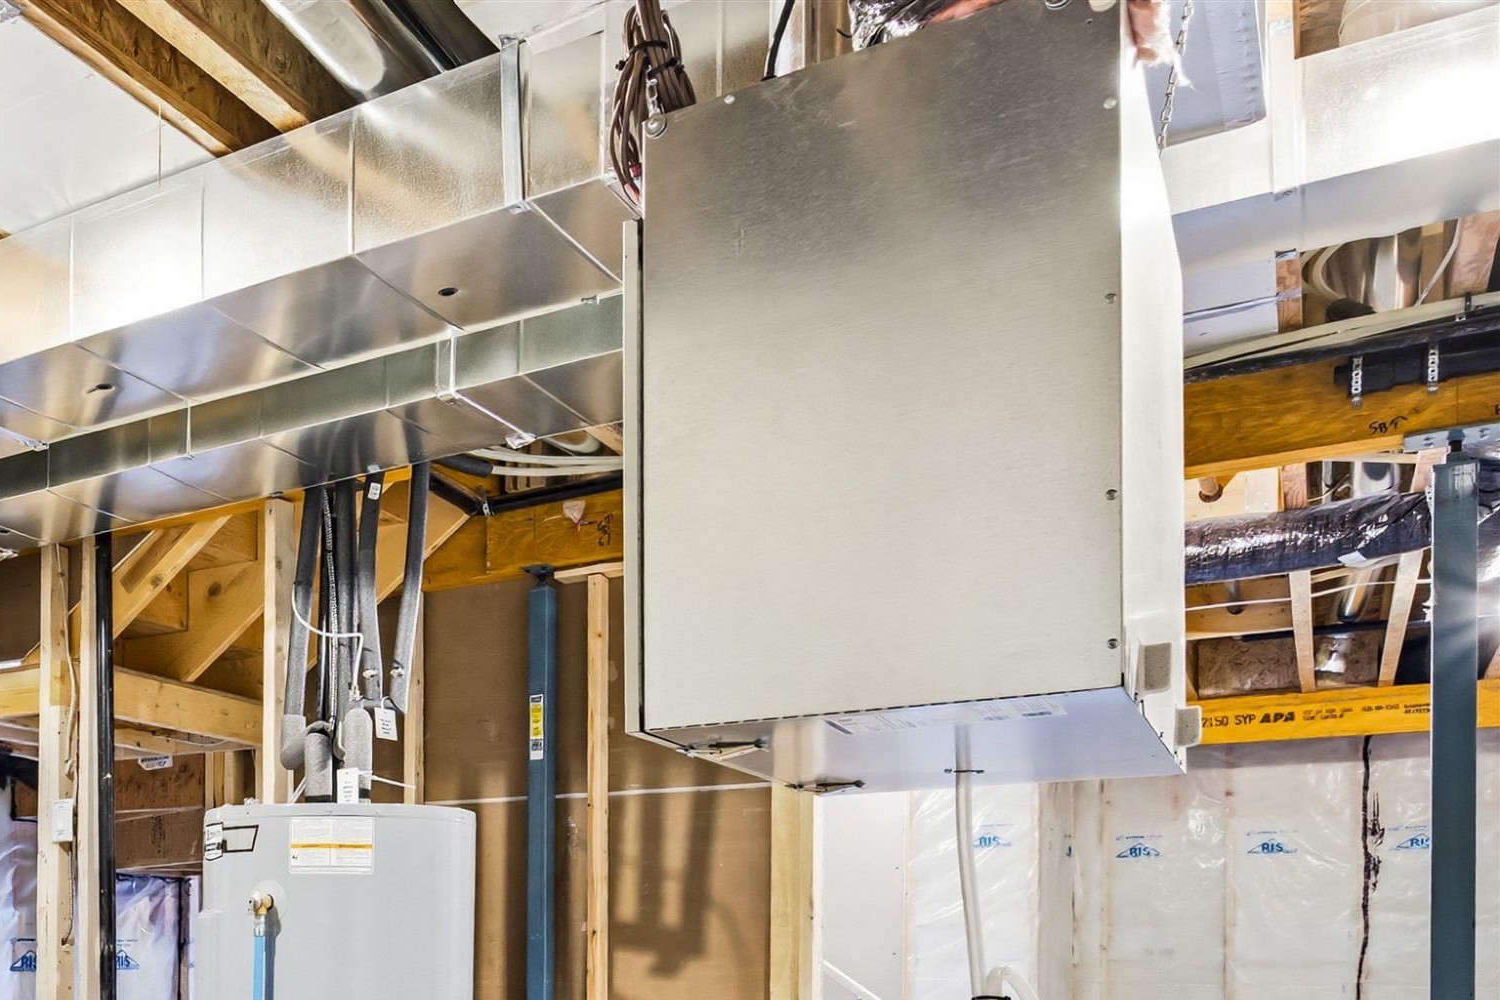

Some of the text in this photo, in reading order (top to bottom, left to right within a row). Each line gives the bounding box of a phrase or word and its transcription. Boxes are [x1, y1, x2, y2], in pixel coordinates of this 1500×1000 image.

[1235, 714, 1256, 726] SYP
[1259, 711, 1295, 724] APA
[1129, 846, 1150, 858] RIS
[1262, 842, 1284, 853] RIS
